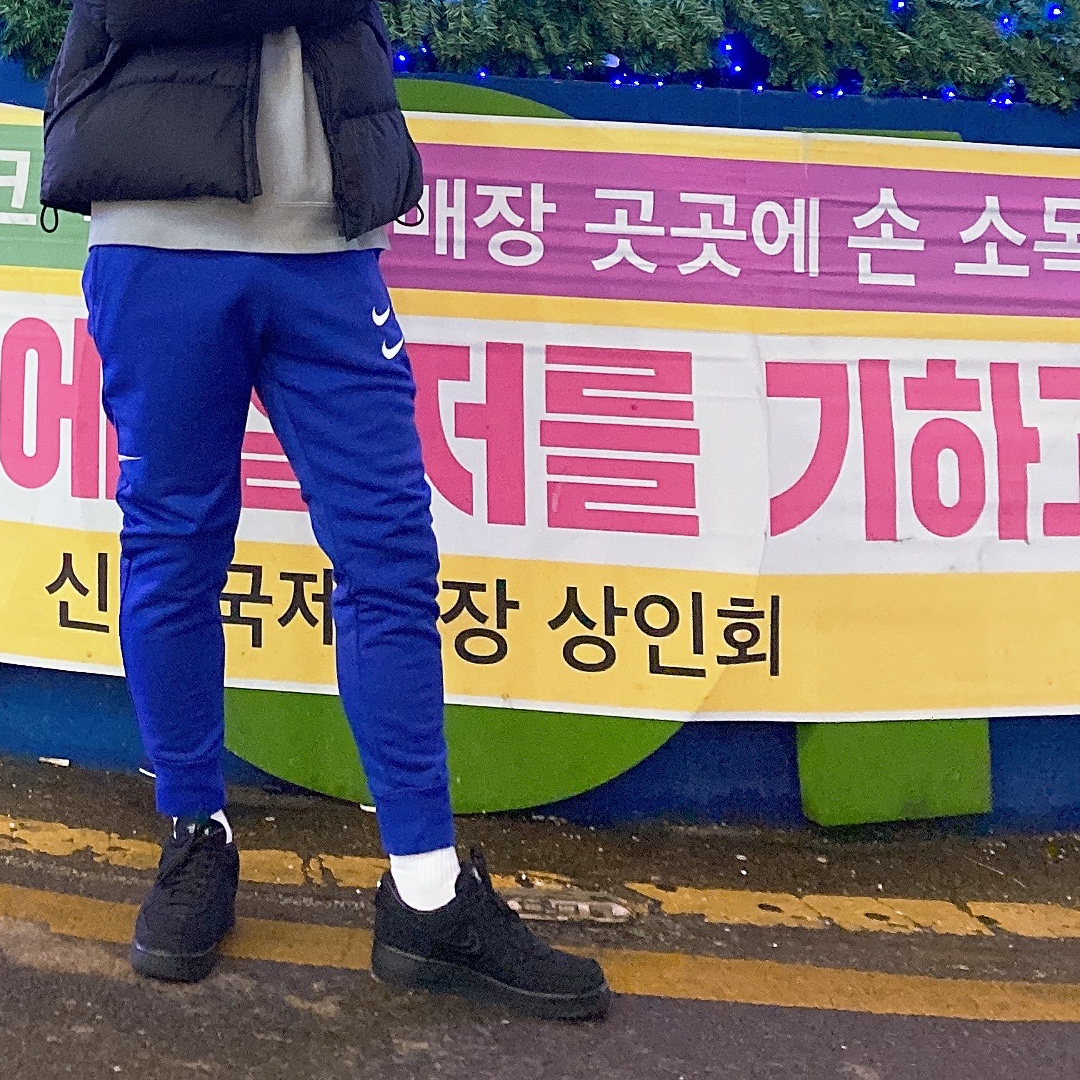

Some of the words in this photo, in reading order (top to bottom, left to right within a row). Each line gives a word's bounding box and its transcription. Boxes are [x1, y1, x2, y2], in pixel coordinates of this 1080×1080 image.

[393, 178, 557, 267] 매장
[585, 187, 821, 278] 곳곳에
[847, 187, 926, 287] 손
[547, 579, 781, 678] 상인회
